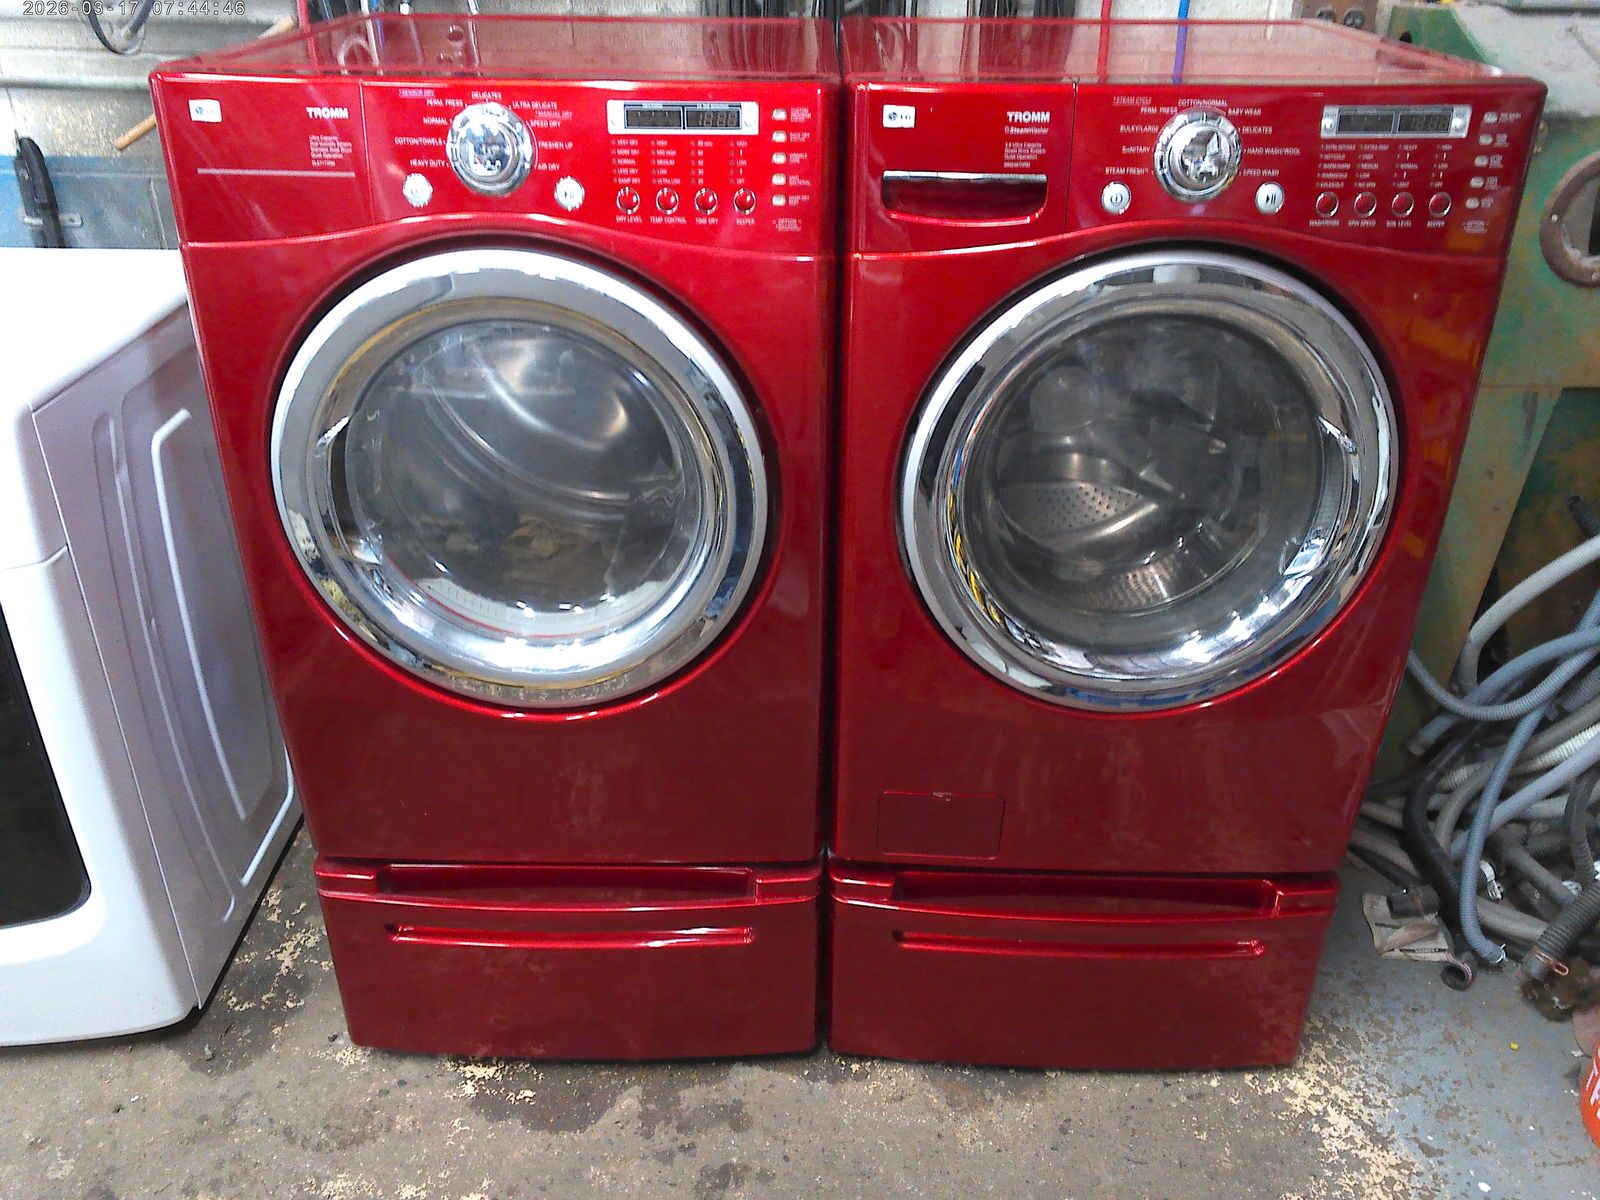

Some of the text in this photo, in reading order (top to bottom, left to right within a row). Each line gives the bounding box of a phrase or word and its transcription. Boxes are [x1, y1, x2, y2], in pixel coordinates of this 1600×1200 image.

[472, 91, 502, 99] DELICATES
[445, 99, 463, 107] PRESS
[512, 101, 531, 109] ULTRA
[306, 106, 349, 119] TROMM
[1160, 106, 1178, 115] PRESS
[1228, 107, 1261, 116] BABY WEAR
[423, 116, 448, 125] NORMAL
[1007, 111, 1050, 123] TROMM
[1242, 126, 1272, 135] DELICATES
[538, 141, 573, 150] FRESHEN UP
[1247, 147, 1264, 155] HAND
[409, 159, 446, 168] HEAVY DUTY
[537, 163, 560, 171] AIR DRY
[1105, 166, 1125, 175] STEAM
